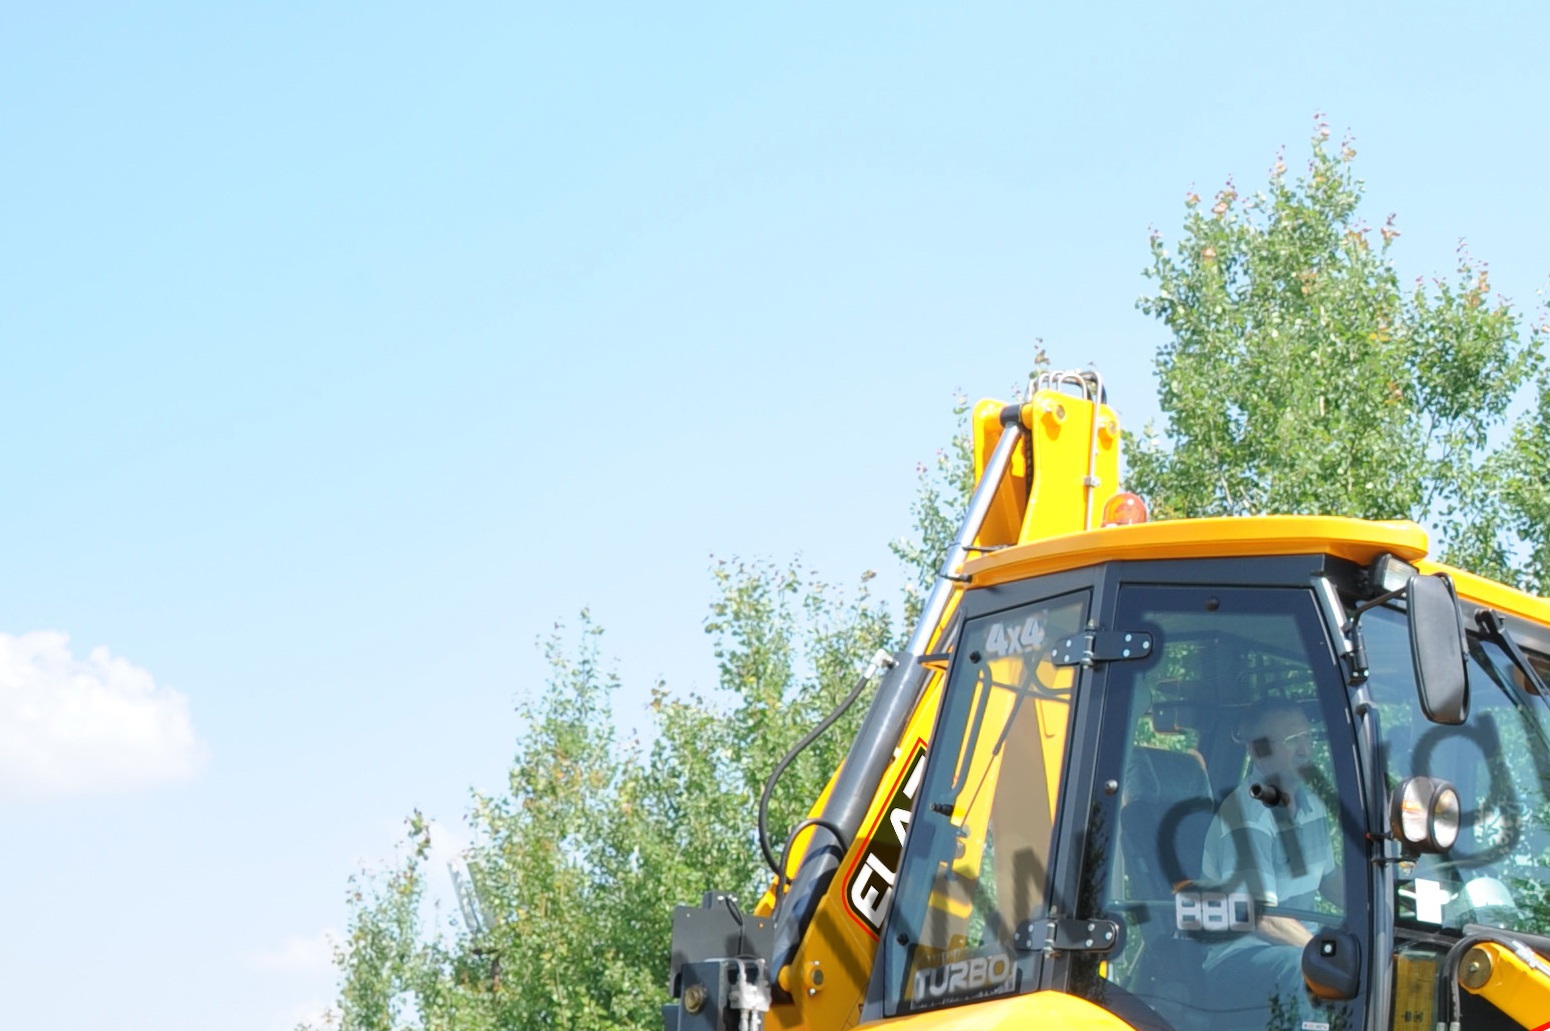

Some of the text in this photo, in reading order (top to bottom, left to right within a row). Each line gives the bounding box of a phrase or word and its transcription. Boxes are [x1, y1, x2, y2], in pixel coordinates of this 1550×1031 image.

[985, 616, 1045, 657] 4x4
[1175, 892, 1256, 931] 880
[914, 953, 1011, 1001] TURBO
